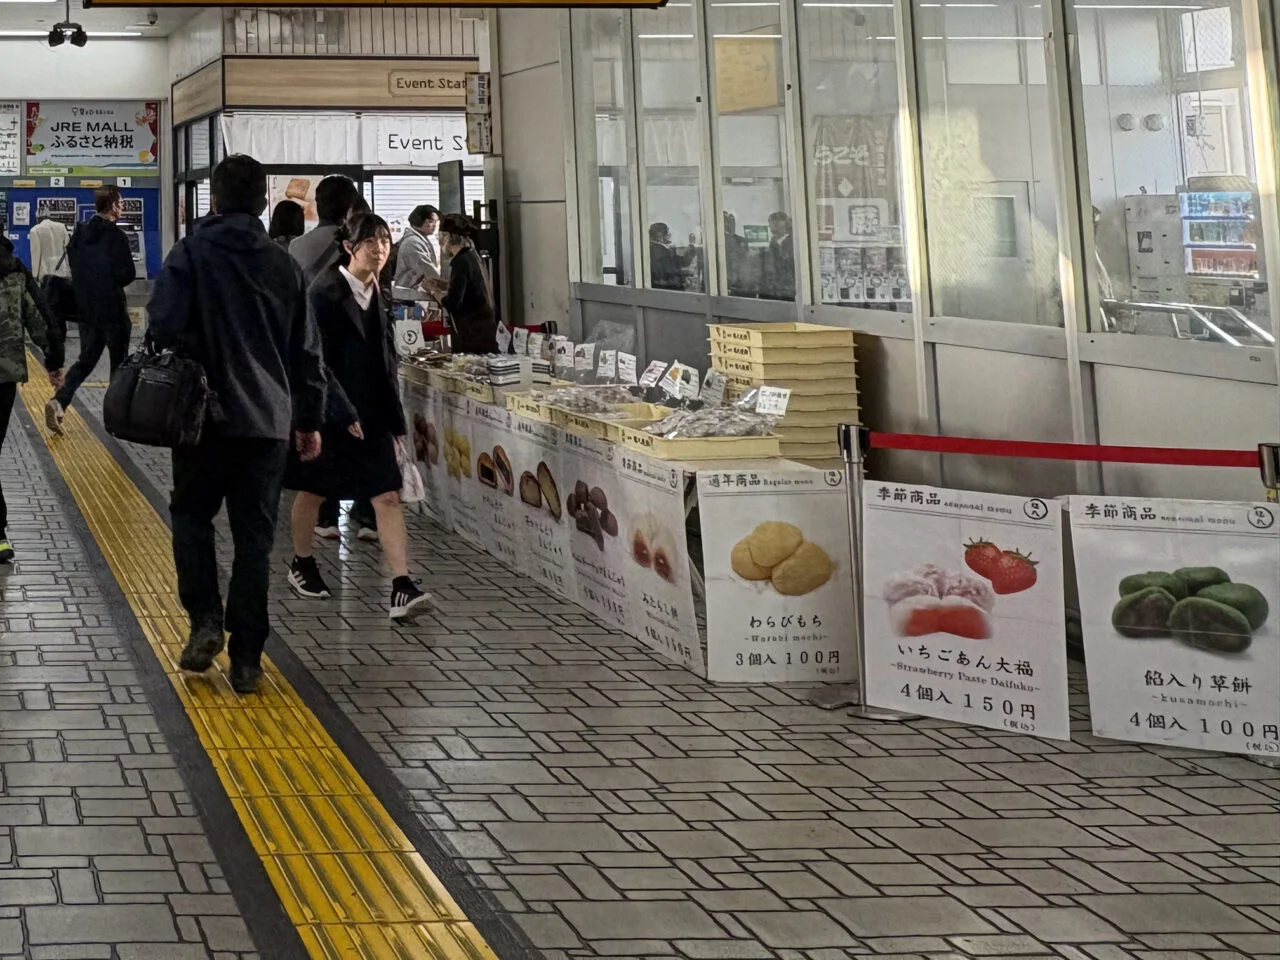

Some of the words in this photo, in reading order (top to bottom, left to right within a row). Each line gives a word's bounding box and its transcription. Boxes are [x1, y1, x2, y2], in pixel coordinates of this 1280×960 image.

[396, 77, 434, 90] Event
[50, 121, 82, 132] JRE
[86, 121, 134, 132] MALL
[50, 134, 134, 149] ふるさと納税
[388, 133, 443, 150] Event
[453, 135, 467, 151] S
[877, 486, 941, 505] 季節商品
[1084, 503, 1157, 521] 季節商品
[749, 614, 822, 628] わらびもち
[735, 651, 777, 666] 3個入
[786, 650, 840, 665] 100円
[897, 643, 1034, 677] いちごあん大福
[958, 671, 987, 685] Paste
[1144, 669, 1253, 695] 餡入り草餅
[900, 683, 953, 705] 4個入
[963, 693, 1036, 721] 150円
[1129, 711, 1188, 732] 4個入
[1200, 718, 1279, 741] 100円
